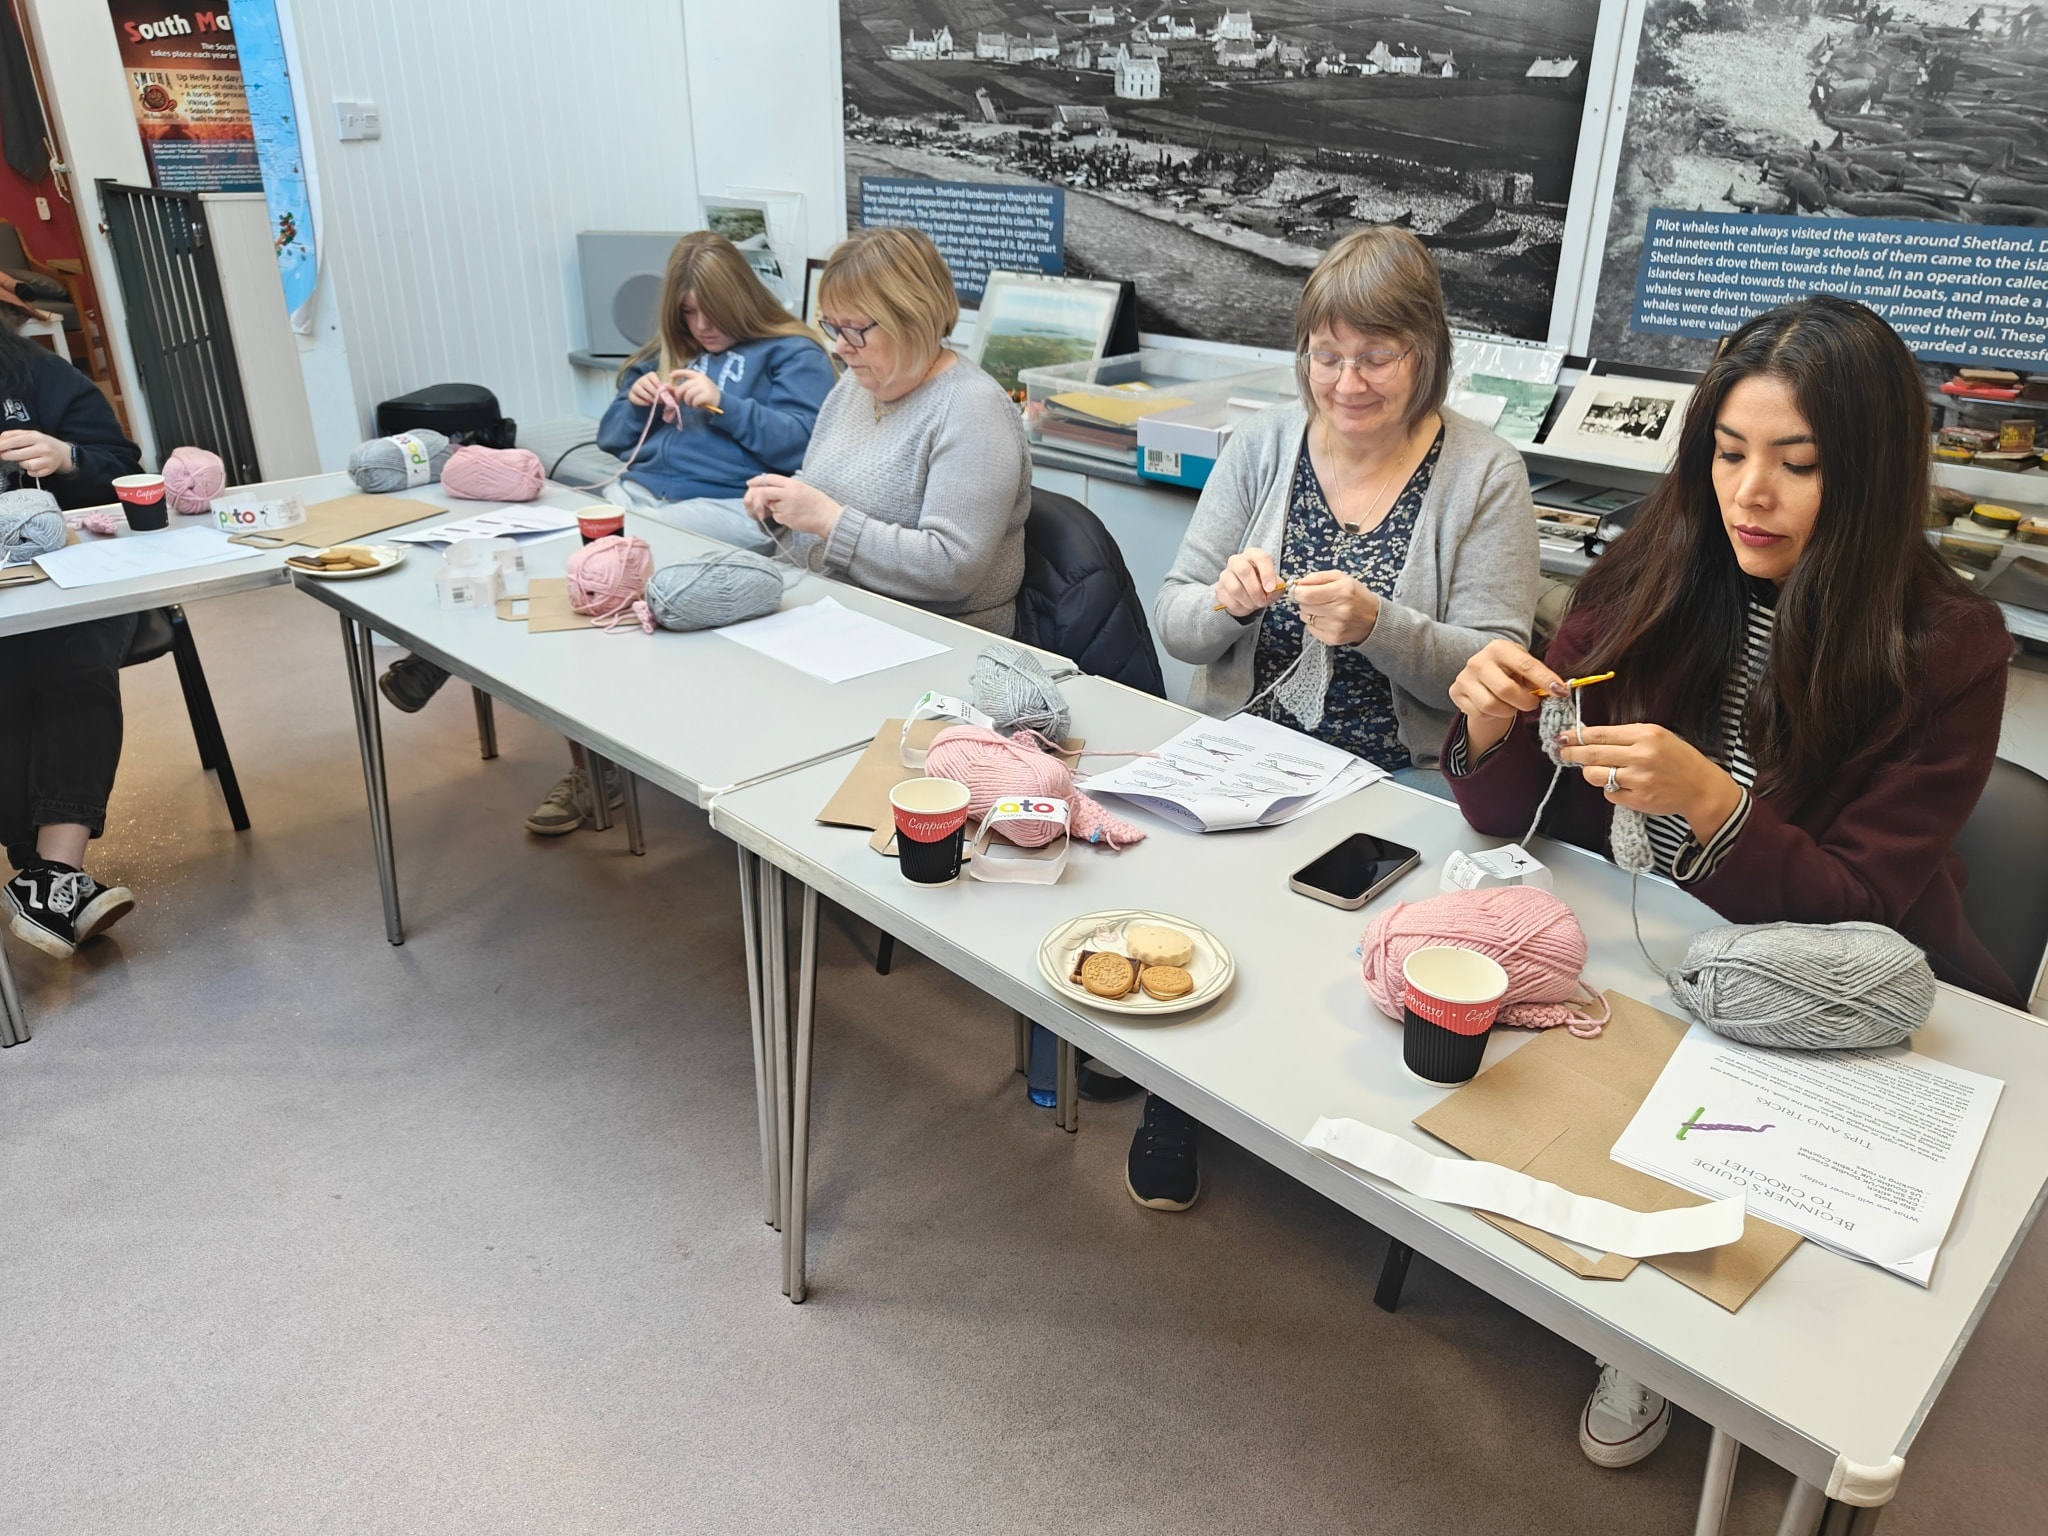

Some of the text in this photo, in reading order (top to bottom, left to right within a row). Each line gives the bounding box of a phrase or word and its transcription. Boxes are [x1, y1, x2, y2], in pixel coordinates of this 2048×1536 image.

[124, 11, 231, 42] South Ma
[150, 49, 171, 57] takes
[172, 50, 192, 59] place
[193, 51, 211, 59] each
[212, 52, 228, 60] year
[201, 42, 214, 50] The
[176, 73, 188, 82] Up
[951, 200, 959, 210] of
[959, 200, 971, 211] the
[971, 201, 990, 212] value
[991, 202, 1000, 213] of
[1000, 203, 1025, 214] whales
[1025, 204, 1049, 216] driven
[966, 189, 1006, 202] landowners
[1007, 192, 1036, 206] thought
[1037, 194, 1053, 205] that
[947, 222, 965, 233] done
[965, 224, 974, 234] all
[975, 224, 987, 235] the
[987, 225, 1005, 236] work
[1006, 226, 1013, 237] in
[1014, 227, 1050, 242] capturing
[968, 212, 999, 224] resented
[999, 214, 1012, 225] this
[1013, 215, 1035, 226] claim.
[1035, 216, 1054, 230] They
[1655, 219, 2035, 252] Pilot whales have always visited the waters around Shetland.
[1650, 251, 1714, 266] Shetlanders
[1715, 255, 1748, 269] drove
[1750, 257, 1779, 271] them
[1781, 261, 1828, 274] towards
[1830, 263, 1851, 276] the
[1853, 264, 1885, 280] land,
[1888, 267, 1902, 280] in
[1904, 271, 1924, 281] an
[1927, 272, 2002, 286] operation
[1653, 236, 2048, 271] and nineteenth centuries large schools of them came to the isla
[1645, 282, 1682, 296] whales
[1684, 288, 1711, 298] were
[1712, 287, 1748, 301] driven
[1889, 303, 1944, 318] pinned
[1946, 307, 1987, 322] them
[1990, 310, 2022, 324] into
[1648, 267, 2042, 308] islanders headed towards the school in small boats, and made a
[1641, 313, 1678, 326] whales
[1680, 318, 1706, 329] were
[1968, 345, 1978, 354] a
[1643, 298, 1680, 311] whales
[1682, 303, 1709, 314] were
[1710, 303, 1738, 316] dead
[1740, 306, 1765, 318] they
[1934, 323, 1972, 337] their
[1974, 327, 1996, 339] oil.
[2001, 328, 2046, 343] These
[1756, 1096, 1872, 1150] TIPS AND TRICKS
[1692, 1158, 1855, 1231] BEGINNER'S GUIDE
[1720, 1159, 1833, 1211] TO CROCHET
[1857, 1196, 1874, 1205] will
[1876, 1203, 1891, 1212] we
[1893, 1209, 1919, 1223] What
